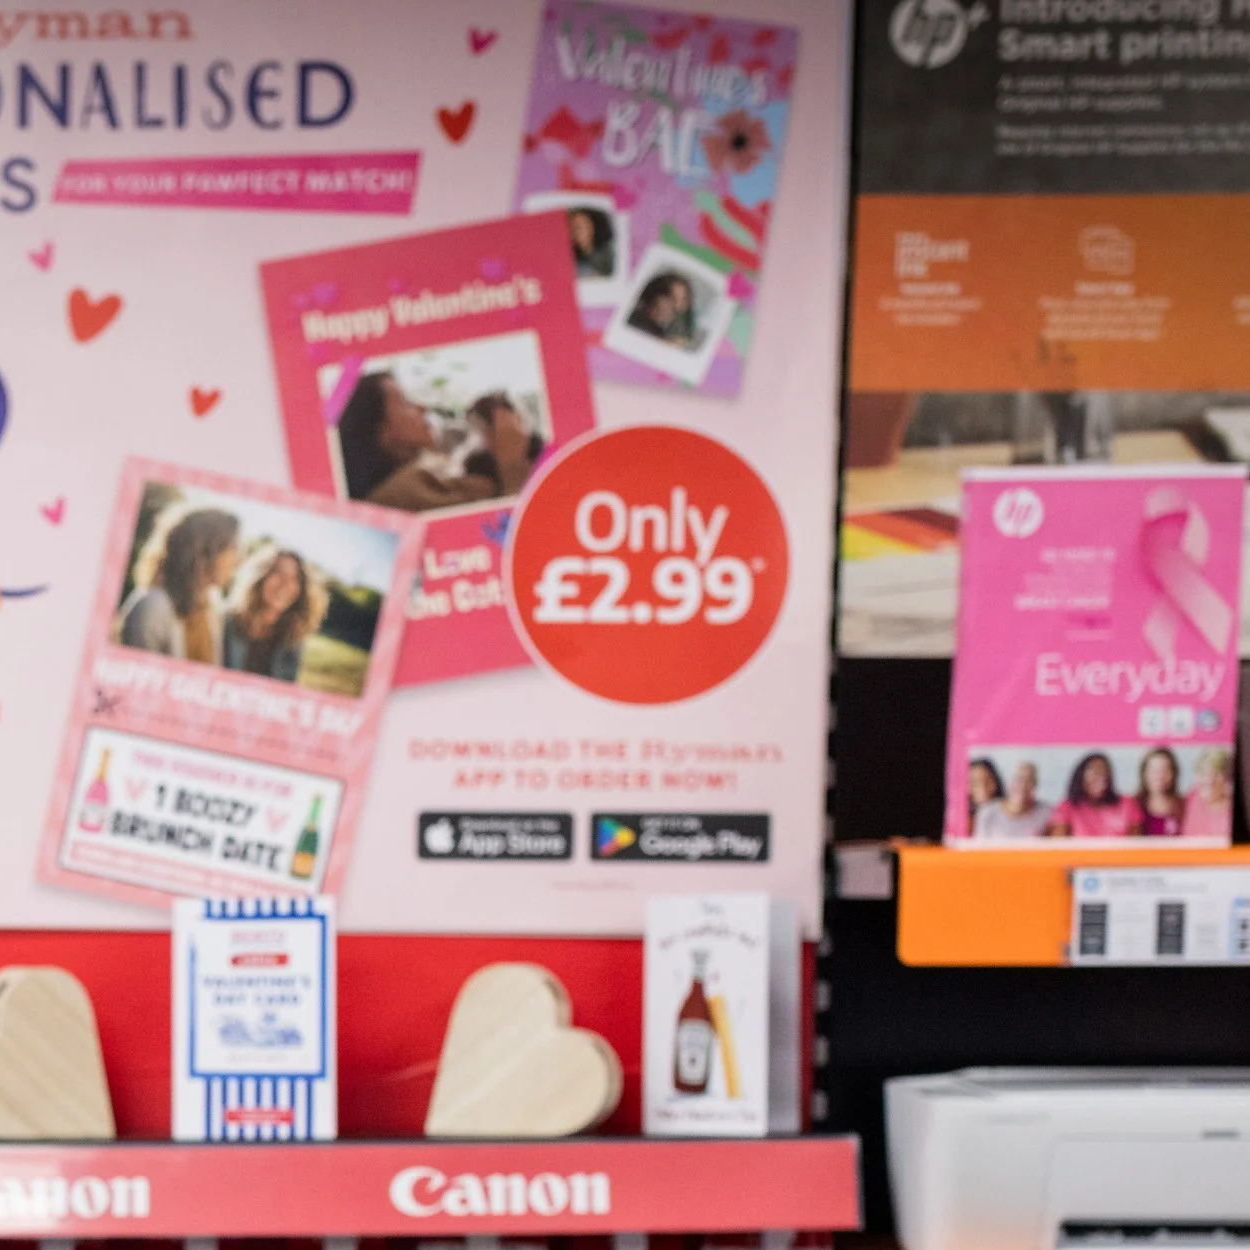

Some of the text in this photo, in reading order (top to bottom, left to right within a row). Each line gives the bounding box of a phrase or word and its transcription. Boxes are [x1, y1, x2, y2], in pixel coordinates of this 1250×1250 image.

[998, 26, 1250, 66] Smart printin
[111, 172, 177, 195] YOUR
[181, 170, 299, 195] PAWFECT
[305, 168, 412, 195] MATCH!
[302, 277, 542, 343] Happy Valentine's
[575, 487, 729, 565] Only
[1036, 652, 1227, 703] Everyday
[408, 740, 571, 762] DOWNLOAD
[581, 740, 627, 762] THE
[455, 769, 504, 790] APP
[515, 769, 548, 790] TO
[558, 769, 652, 790] ORDER
[110, 810, 215, 852] BRUNCH
[222, 836, 285, 871] DATE
[459, 831, 568, 857] App Store
[639, 831, 763, 861] Google Play
[390, 1165, 611, 1218] Canon
